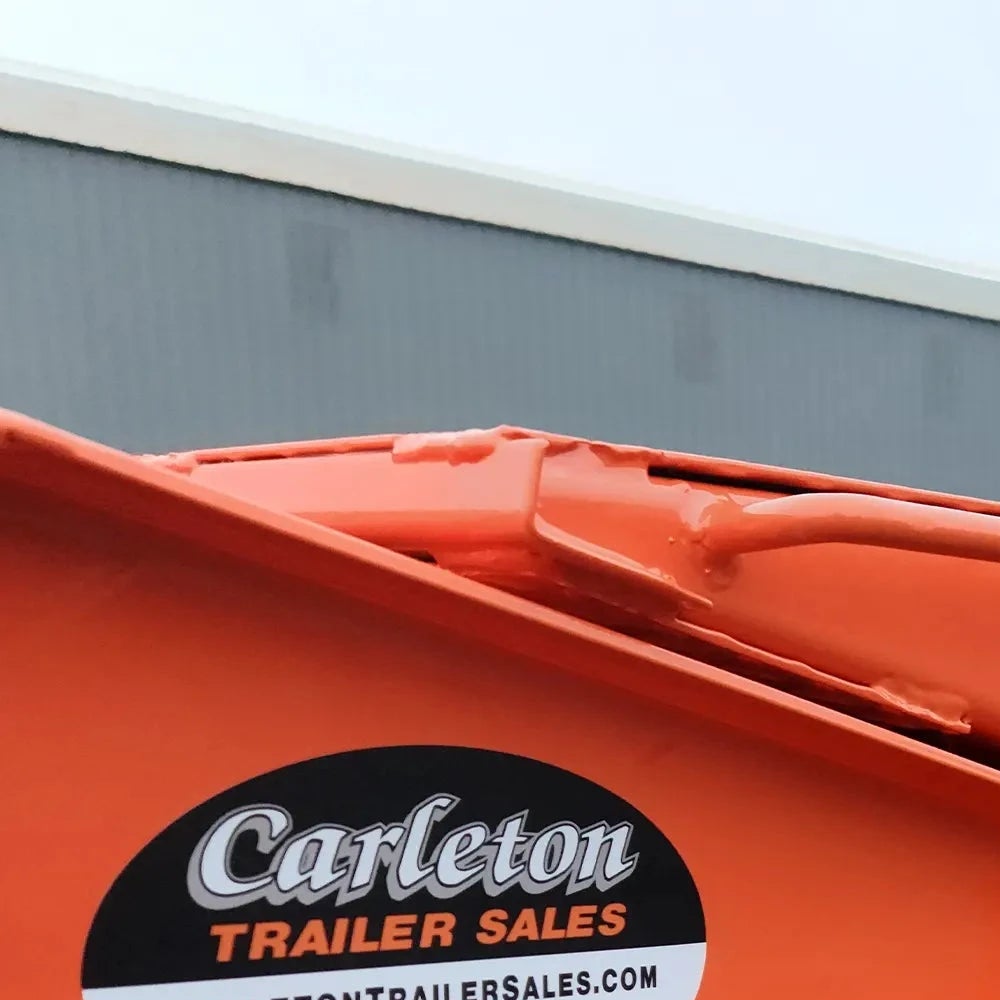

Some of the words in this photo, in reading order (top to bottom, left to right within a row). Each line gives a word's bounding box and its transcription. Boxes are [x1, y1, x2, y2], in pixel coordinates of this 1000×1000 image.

[187, 793, 639, 910] Carleton
[209, 912, 457, 963] TRAILER
[475, 903, 627, 945] SALES
